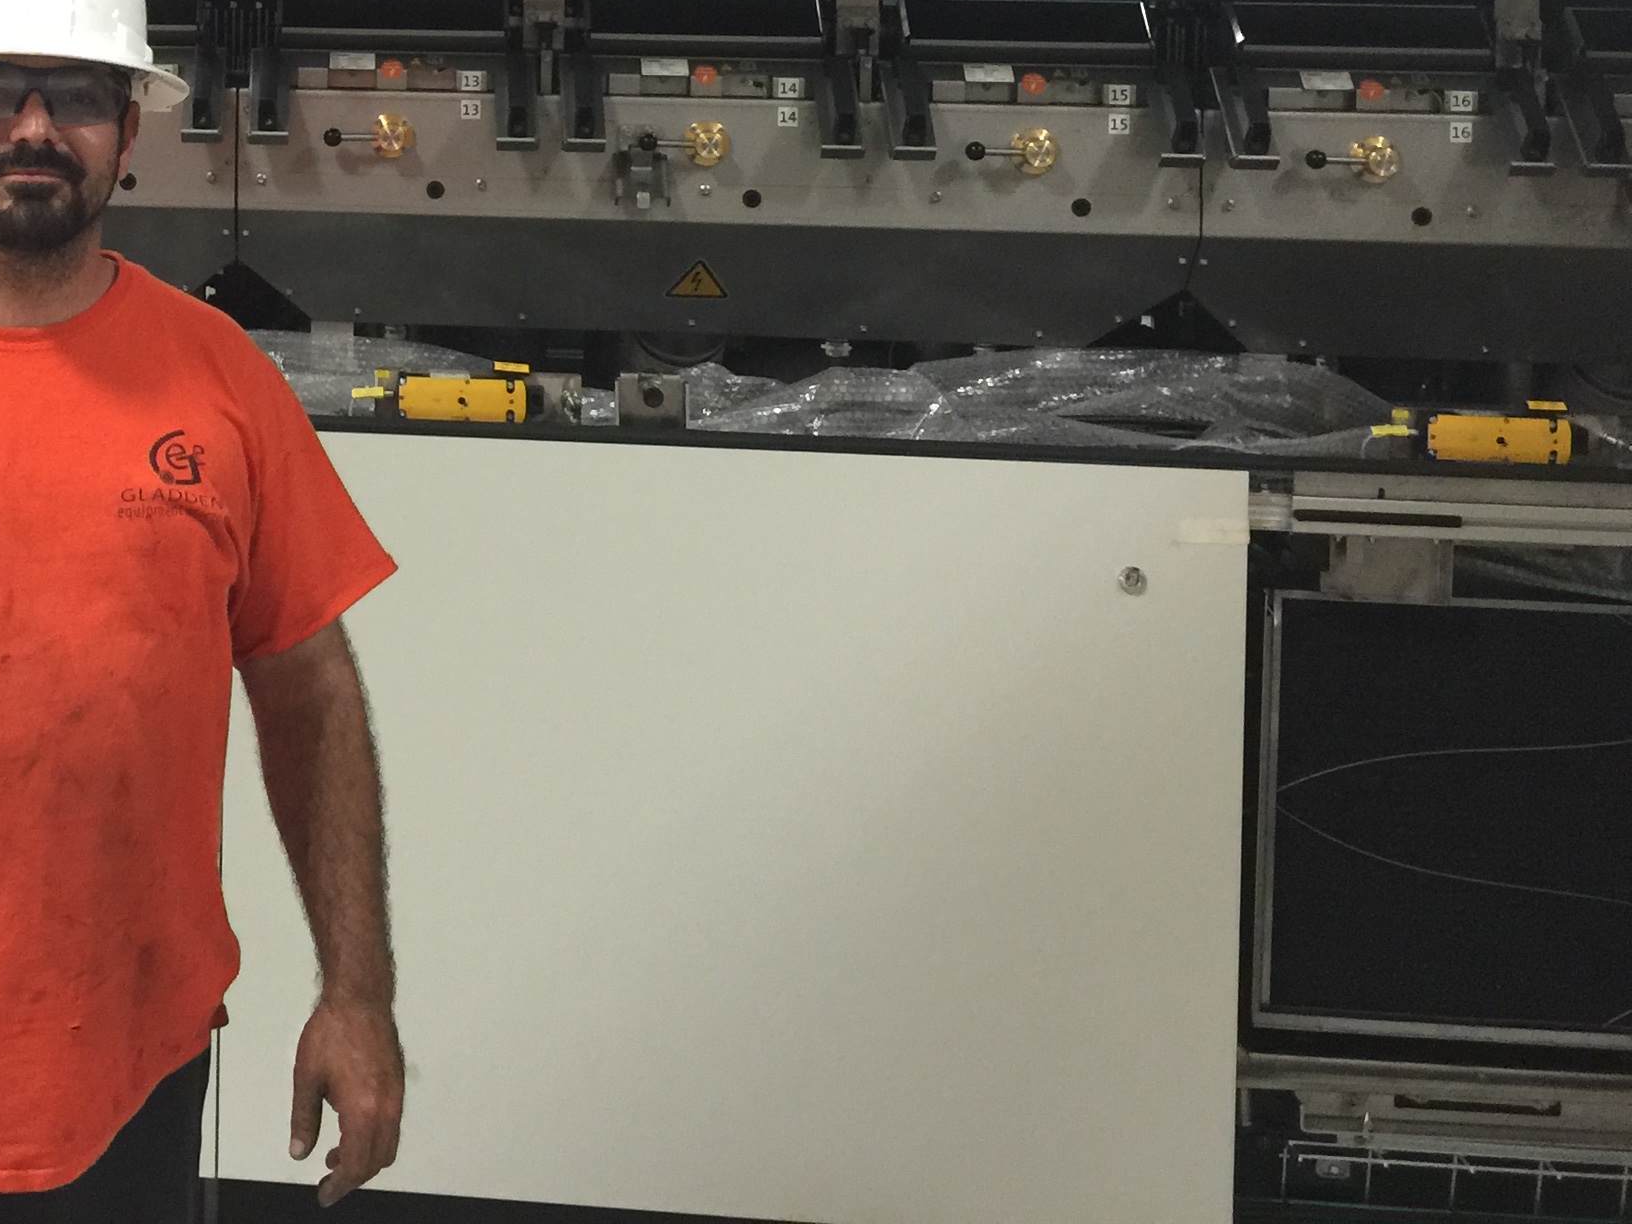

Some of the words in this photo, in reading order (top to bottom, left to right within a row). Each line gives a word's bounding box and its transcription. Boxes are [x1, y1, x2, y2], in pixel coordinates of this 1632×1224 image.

[463, 75, 480, 88] 13
[780, 82, 798, 95] 14
[1111, 89, 1128, 102] 15
[1453, 94, 1471, 108] 16
[462, 104, 479, 116] 13
[779, 111, 798, 124] 14
[1110, 118, 1128, 131] 15
[1451, 126, 1471, 139] 16
[120, 487, 224, 510] GLADDEN
